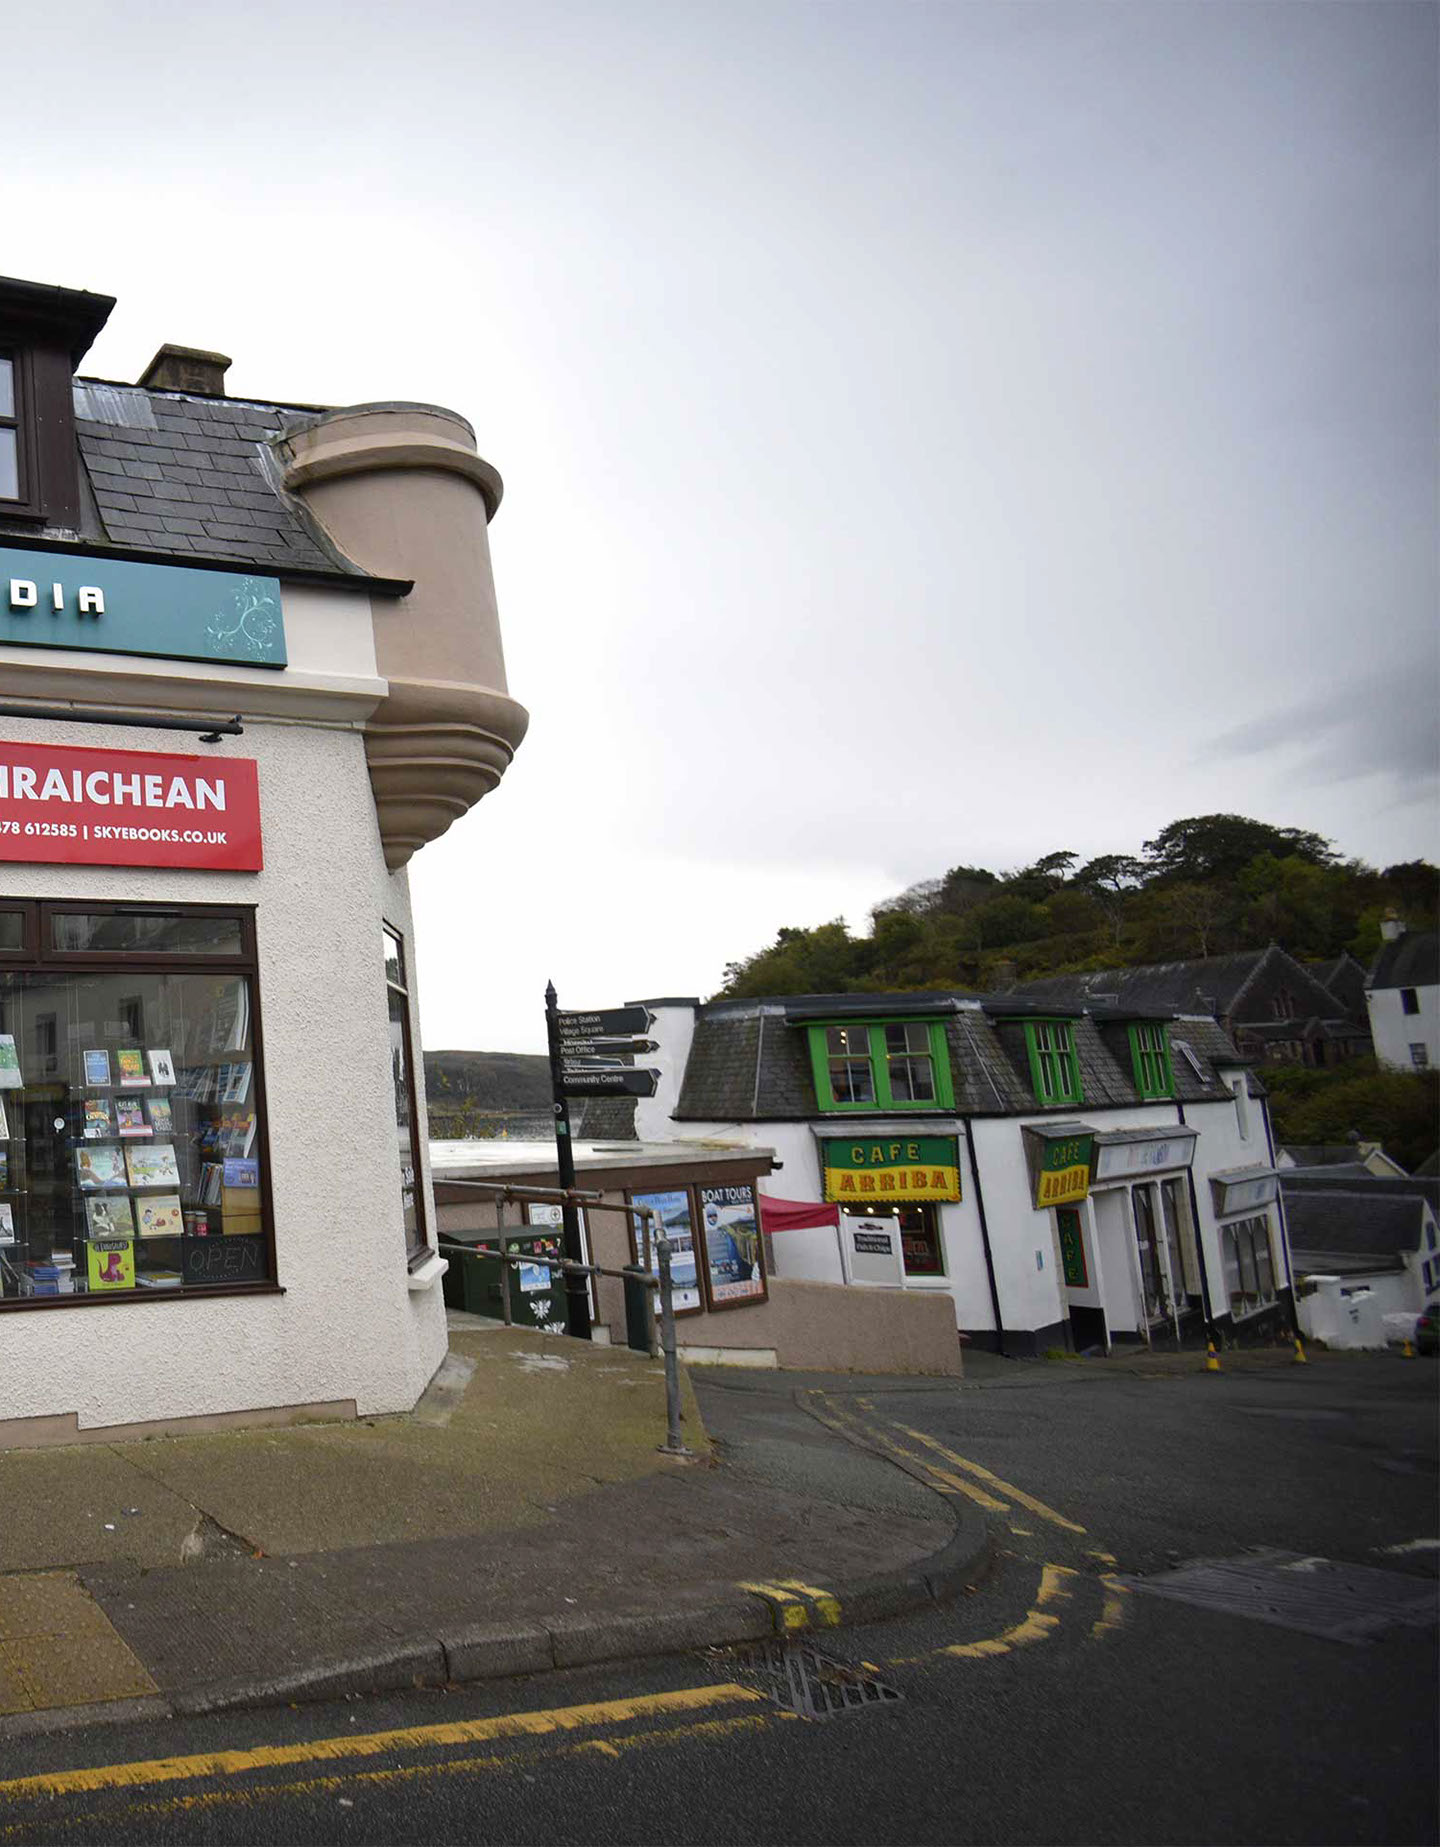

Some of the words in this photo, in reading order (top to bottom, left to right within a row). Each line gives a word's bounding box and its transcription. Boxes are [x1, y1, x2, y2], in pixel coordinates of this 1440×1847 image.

[24, 821, 78, 839] 612585
[93, 825, 228, 846] SKYEBOOKS.CO.UK
[558, 1017, 578, 1027] Police
[579, 1015, 601, 1025] Station
[559, 1027, 580, 1037] Village
[581, 1025, 604, 1036] Square
[561, 1046, 575, 1055] Post
[576, 1045, 596, 1054] Office
[563, 1075, 601, 1085] Community
[601, 1074, 624, 1083] Centre
[851, 1142, 921, 1165] CAFE
[1053, 1140, 1081, 1167] CAFE
[839, 1170, 950, 1193] ARRIBA
[1044, 1168, 1086, 1199] ARRIBA
[701, 1188, 725, 1203] BOAT
[725, 1185, 753, 1201] TOURS
[189, 1246, 259, 1272] OPEN
